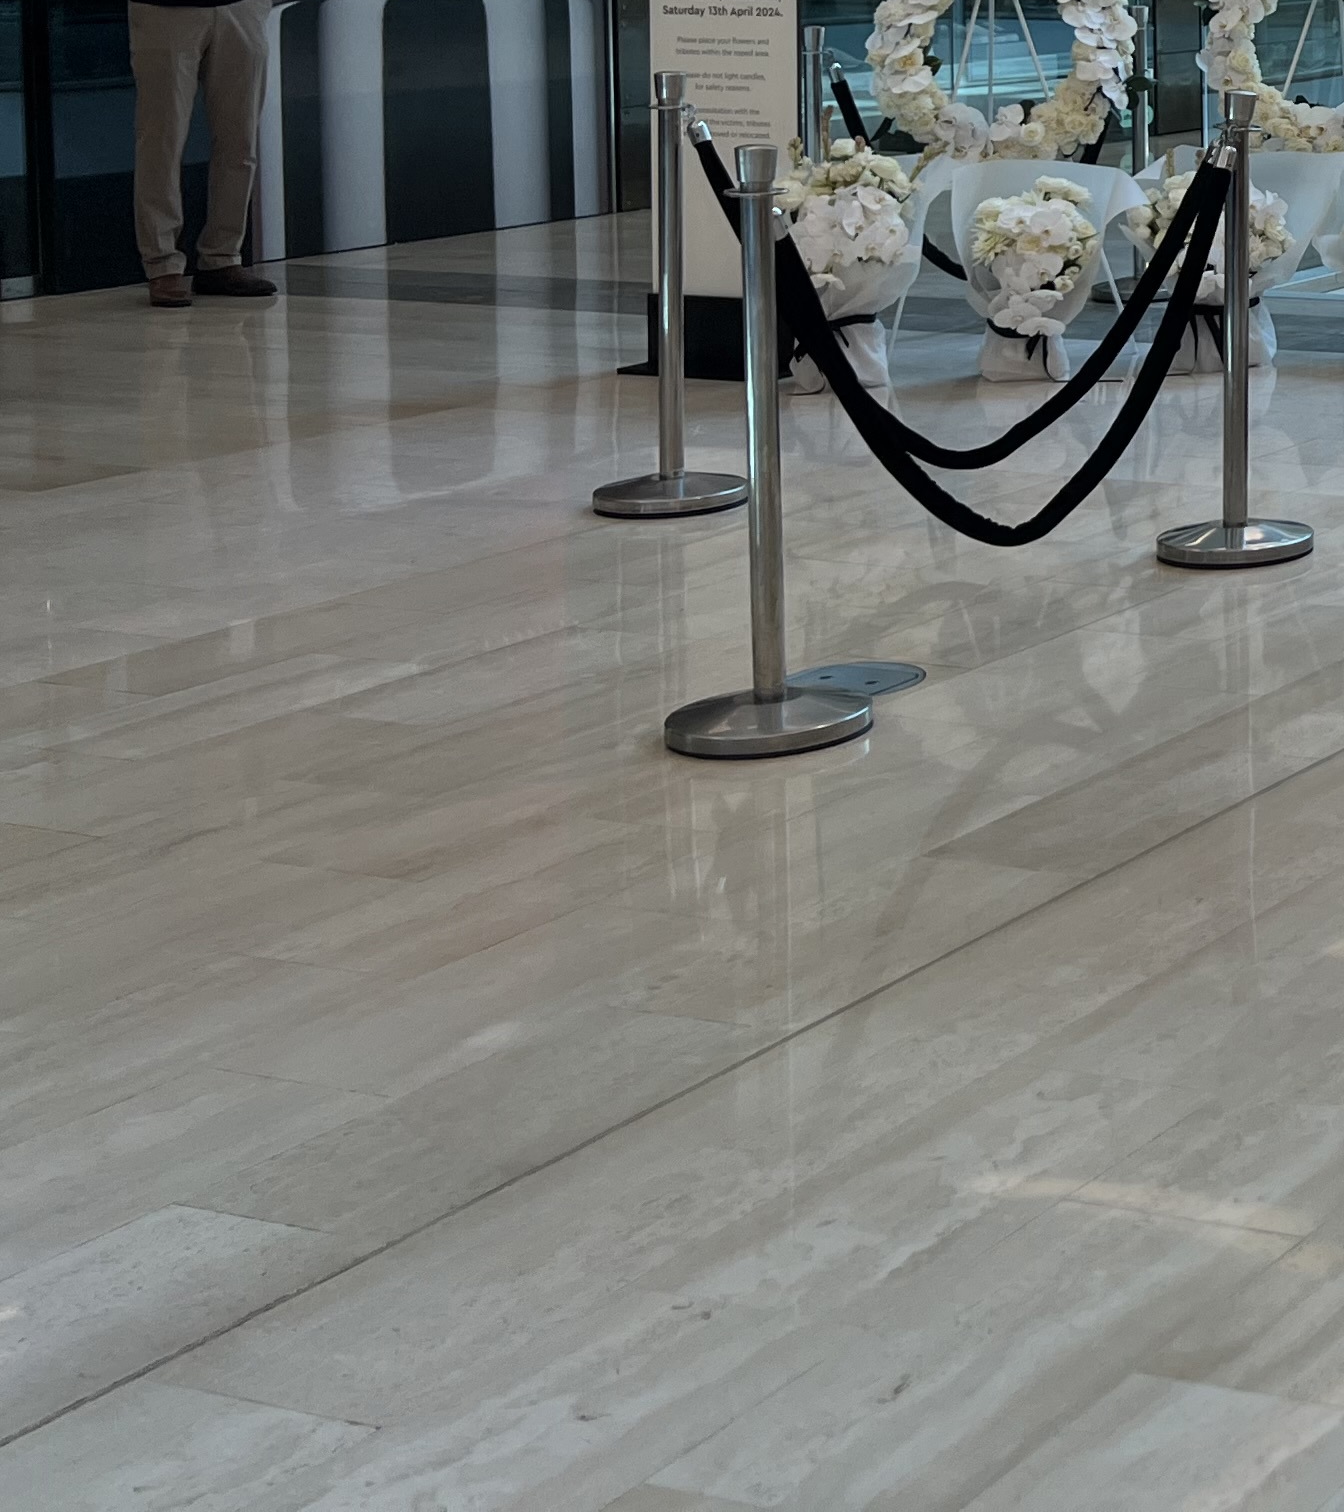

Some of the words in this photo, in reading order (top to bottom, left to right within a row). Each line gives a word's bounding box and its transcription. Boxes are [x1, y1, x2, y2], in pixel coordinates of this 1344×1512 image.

[663, 5, 705, 17] Saturday
[709, 6, 728, 16] 13th
[730, 6, 753, 17] April
[756, 7, 783, 17] 2024.
